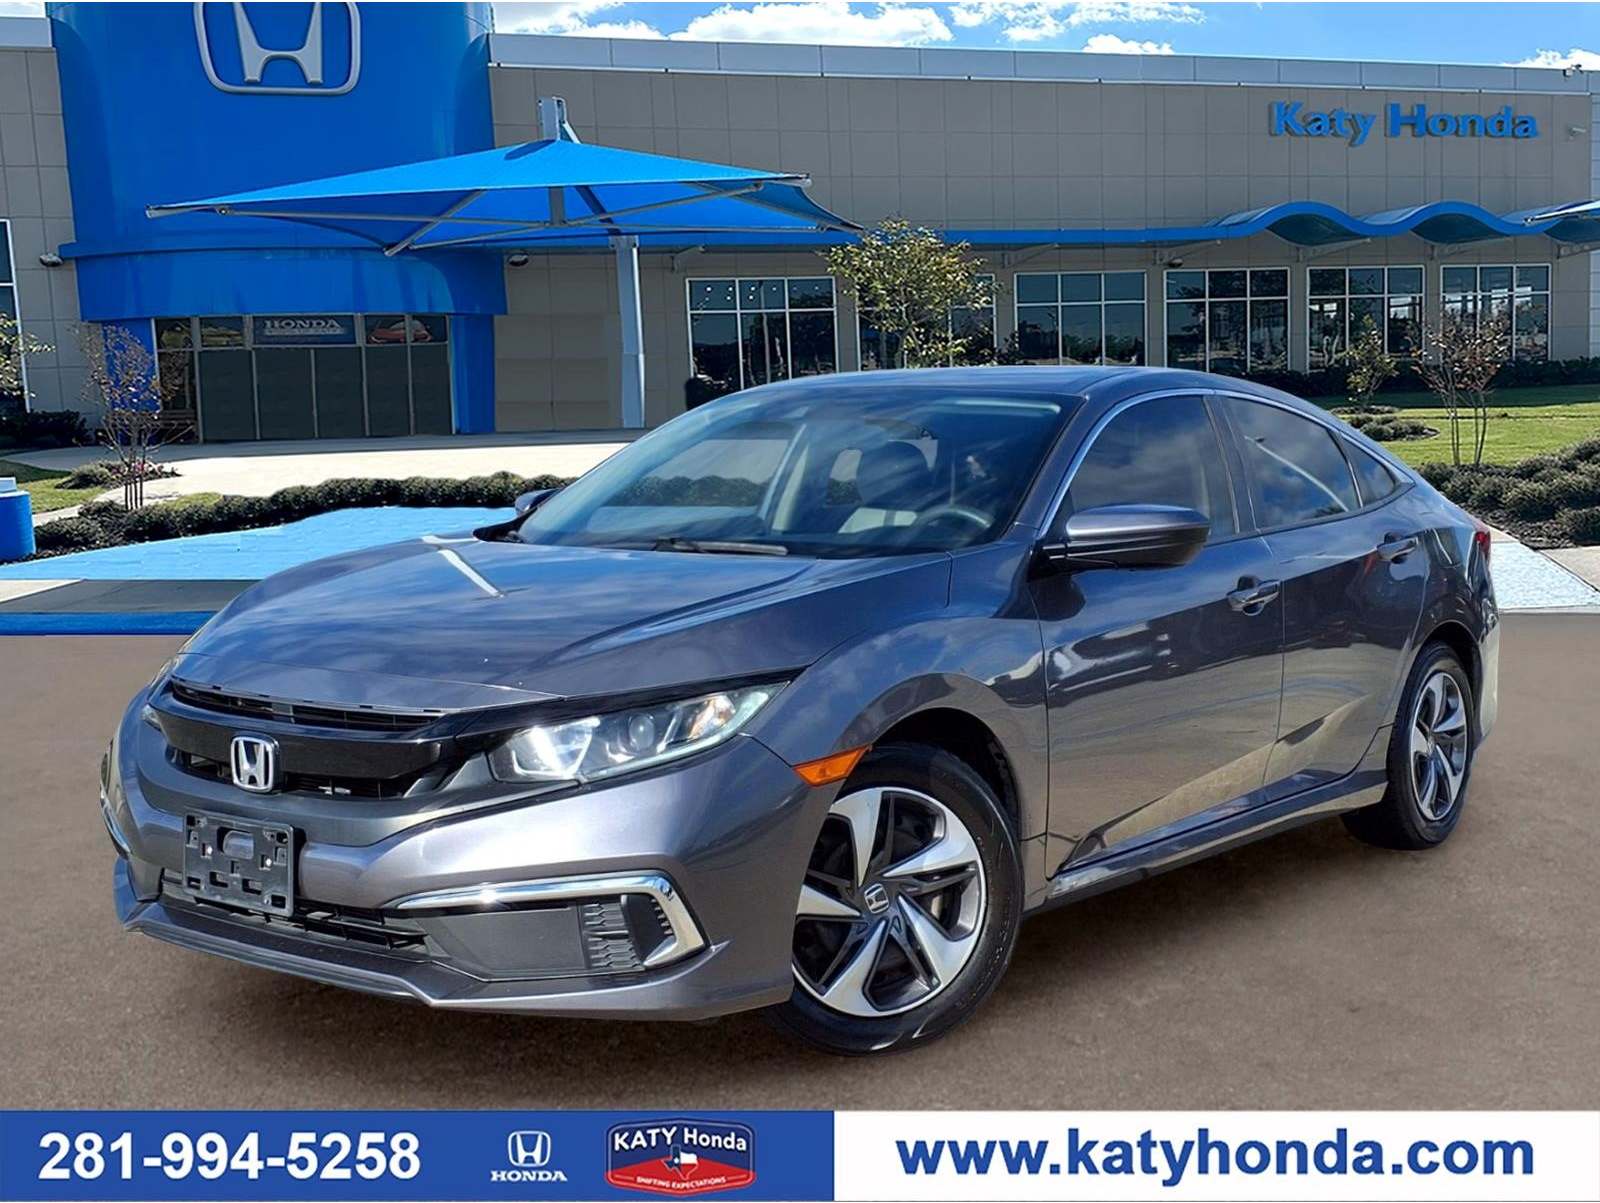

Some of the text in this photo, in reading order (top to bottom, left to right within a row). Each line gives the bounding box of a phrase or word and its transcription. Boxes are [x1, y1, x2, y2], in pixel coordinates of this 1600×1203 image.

[1270, 101, 1540, 146] Katy Honda
[265, 319, 342, 329] HONDA
